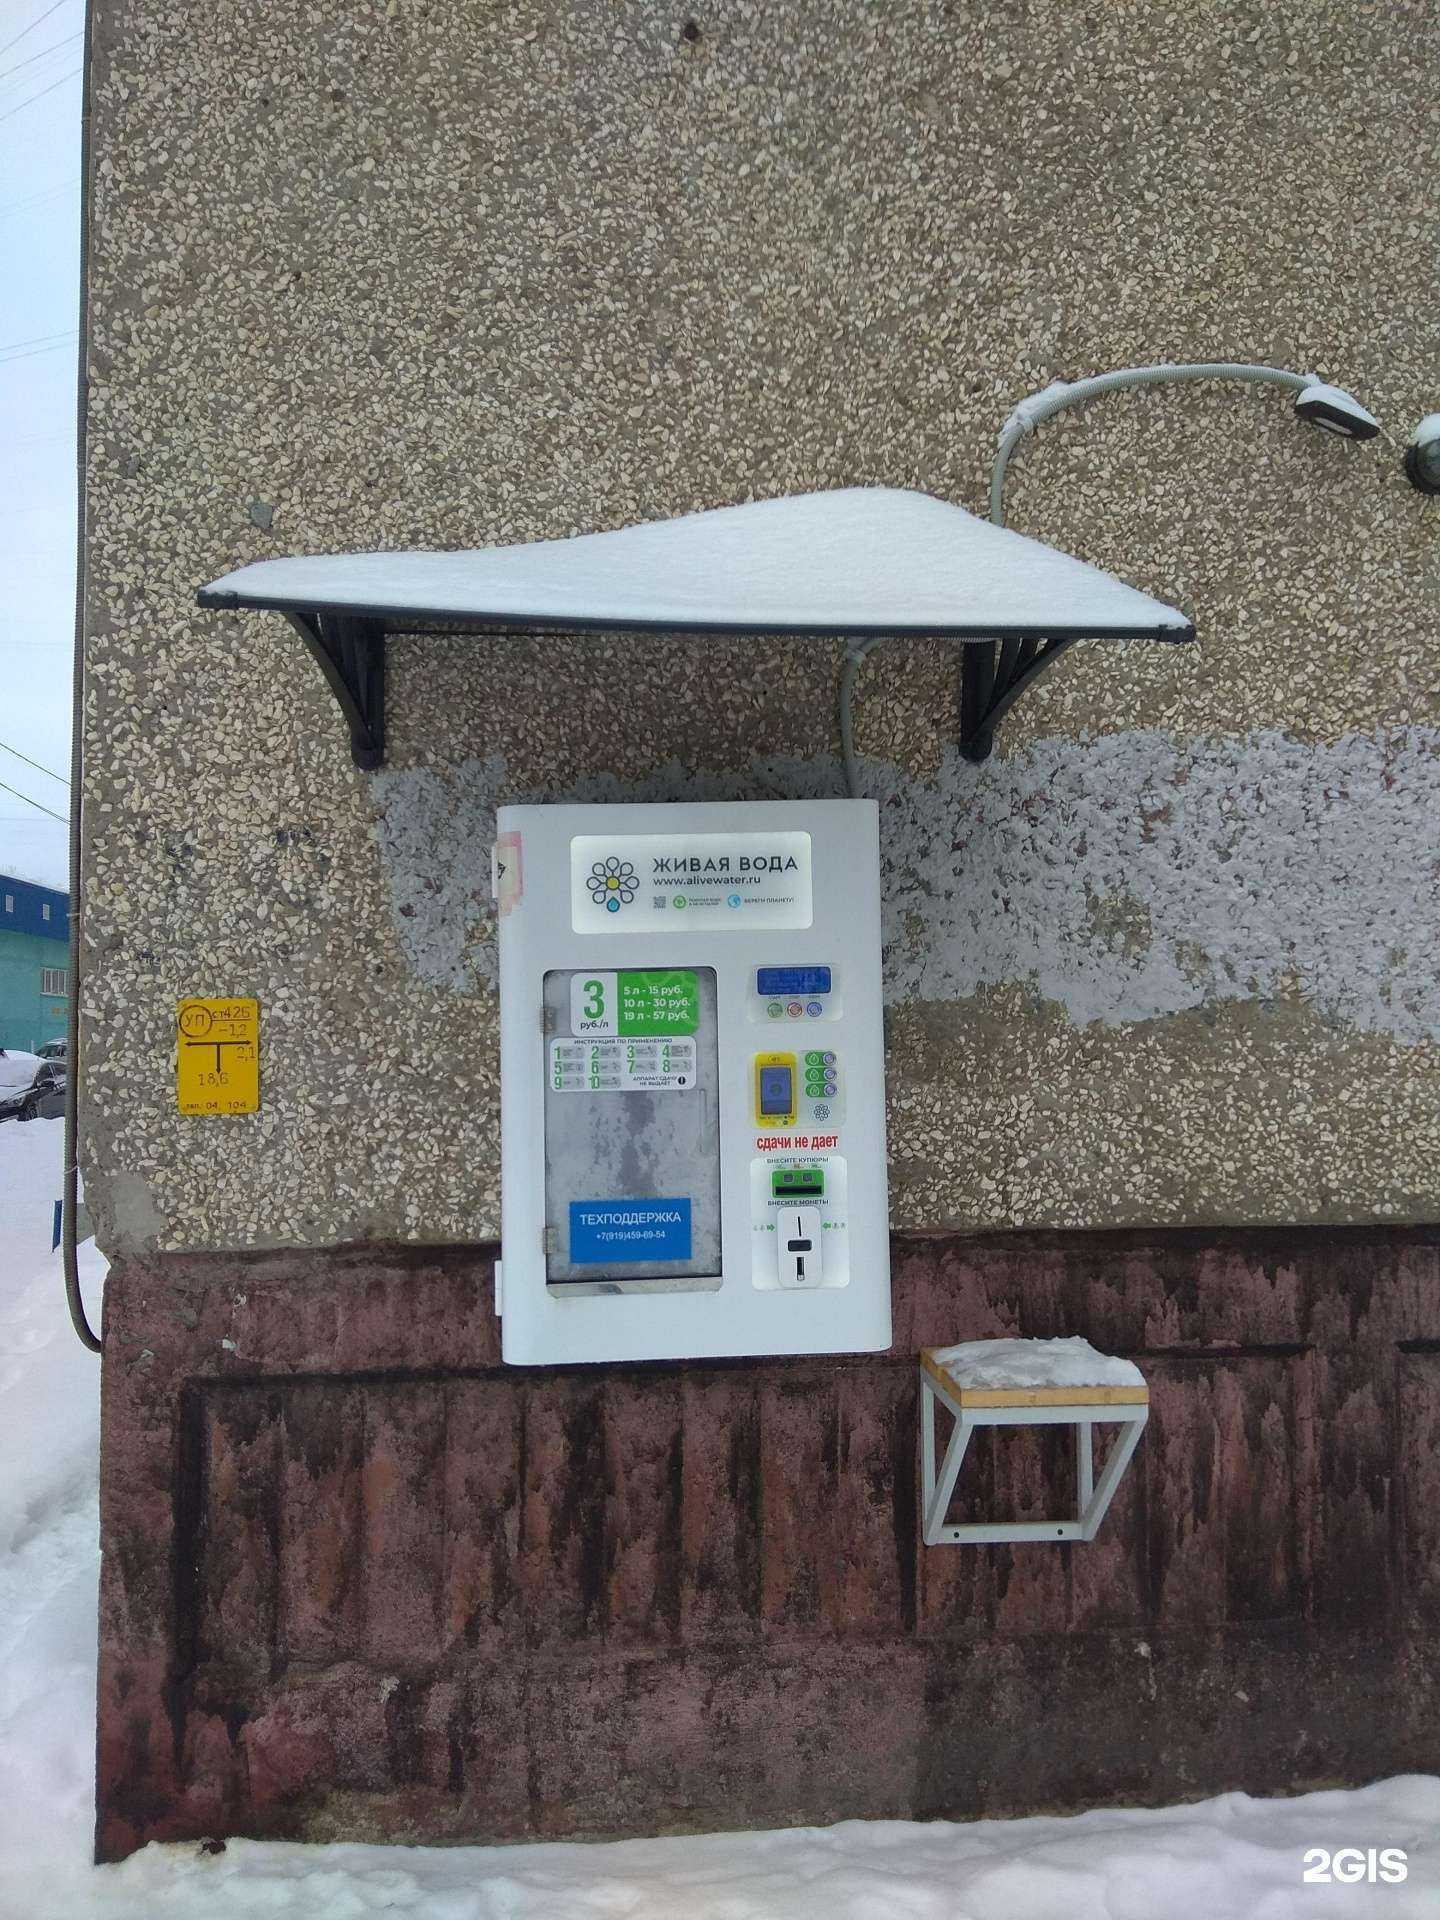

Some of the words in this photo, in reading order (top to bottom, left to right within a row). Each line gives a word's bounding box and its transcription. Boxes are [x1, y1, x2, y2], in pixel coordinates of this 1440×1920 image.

[652, 857, 730, 873] ЖИВАЯ
[739, 856, 798, 873] ВОДА
[653, 875, 761, 886] www.alivewater.ru
[624, 987, 631, 995] 5
[649, 986, 659, 994] 15
[661, 985, 683, 996] руб.
[583, 980, 605, 1019] 3
[624, 999, 635, 1007] 10
[653, 999, 666, 1007] 30
[669, 998, 691, 1009] руб.
[624, 1012, 635, 1020] 19
[653, 1011, 665, 1019] 57
[667, 1010, 690, 1021] руб.
[580, 1019, 609, 1030] руб./л
[554, 1046, 561, 1060] 1
[591, 1046, 600, 1059] 2
[626, 1045, 635, 1058] 3
[662, 1044, 671, 1058] 4
[554, 1062, 562, 1075] 5
[591, 1061, 599, 1074] 6
[626, 1060, 634, 1073] 7
[662, 1060, 671, 1073] 8
[554, 1076, 562, 1089] 9
[590, 1076, 600, 1089] 10
[756, 1137, 792, 1151] сдачи
[794, 1136, 808, 1148] не
[811, 1135, 839, 1150] дает
[579, 1211, 682, 1226] ТЕХПОДДЕРЖКА
